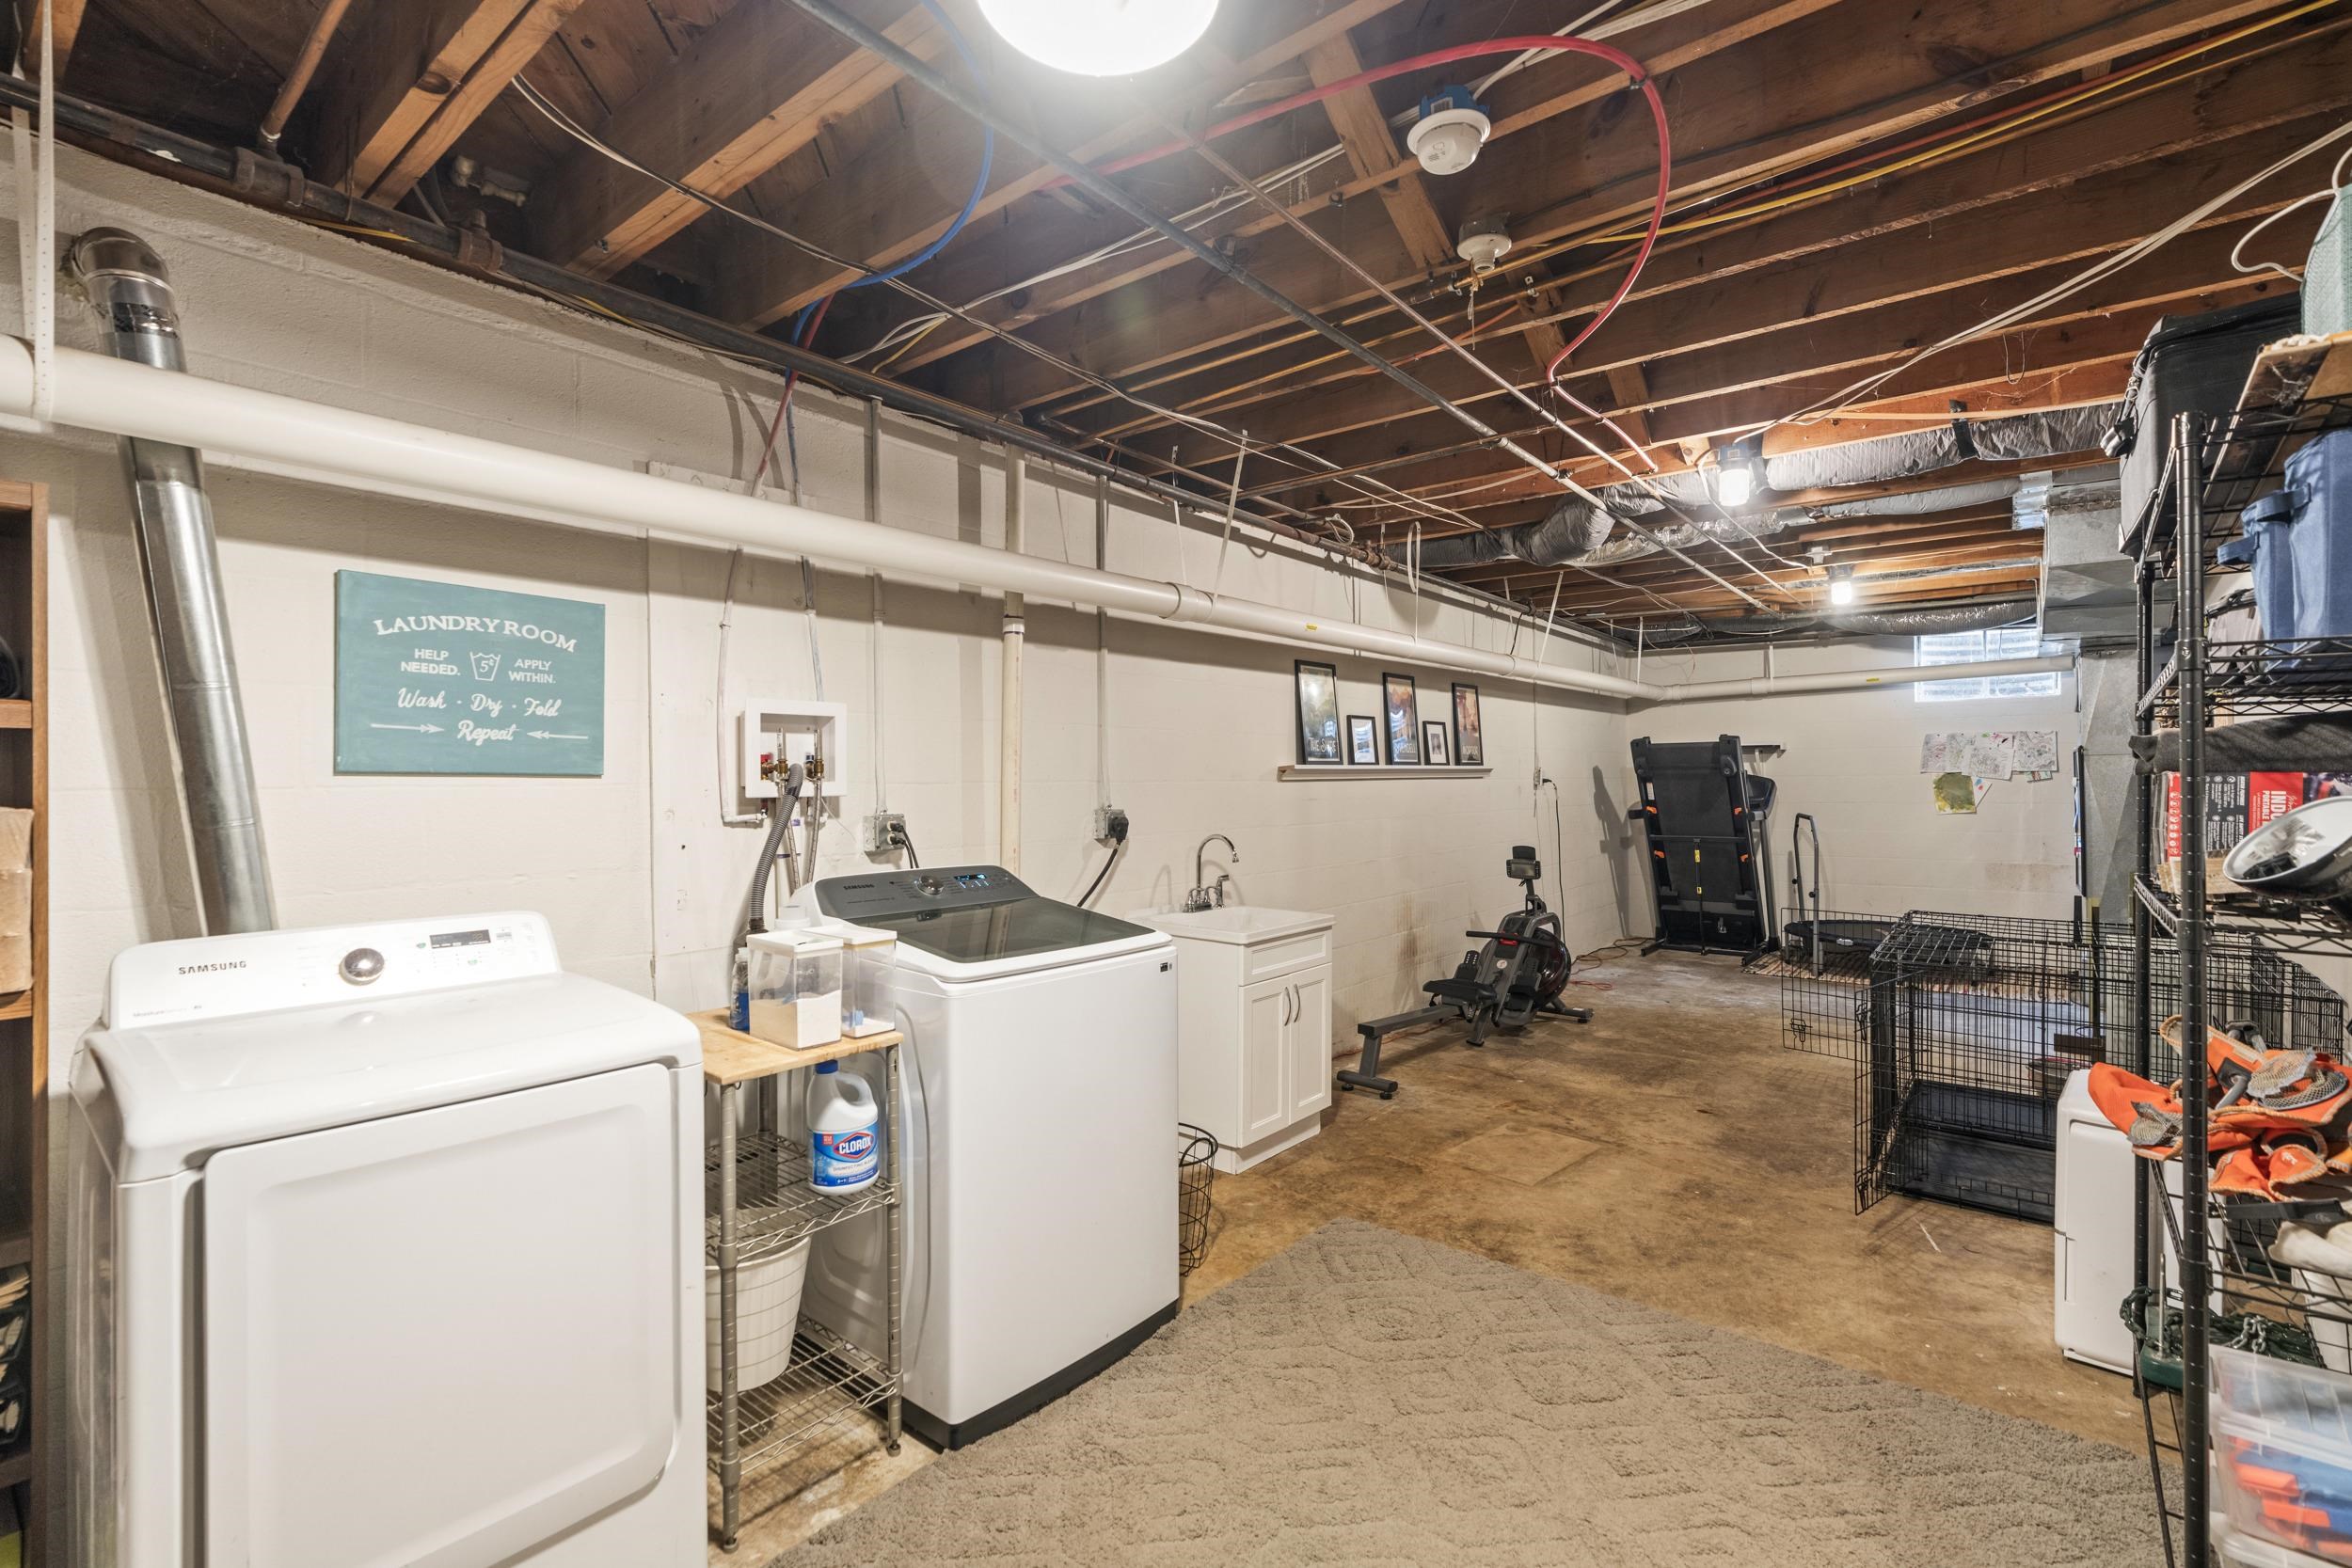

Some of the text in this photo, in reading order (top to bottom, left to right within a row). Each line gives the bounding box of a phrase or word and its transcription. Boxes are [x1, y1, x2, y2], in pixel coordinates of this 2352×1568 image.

[373, 615, 578, 653] LAUNDRY ROOM
[414, 648, 449, 661] HELP
[401, 661, 461, 675] NEEDED.
[514, 658, 551, 671] APPLY
[508, 670, 556, 684] WITHIN.
[398, 688, 562, 718] Wash Dry Fold
[457, 720, 517, 746] Repeat
[1308, 737, 1320, 752] THE
[2262, 790, 2270, 820] PORTABLE
[179, 960, 247, 975] SAMSUNG
[838, 1135, 872, 1154] CLOROX
